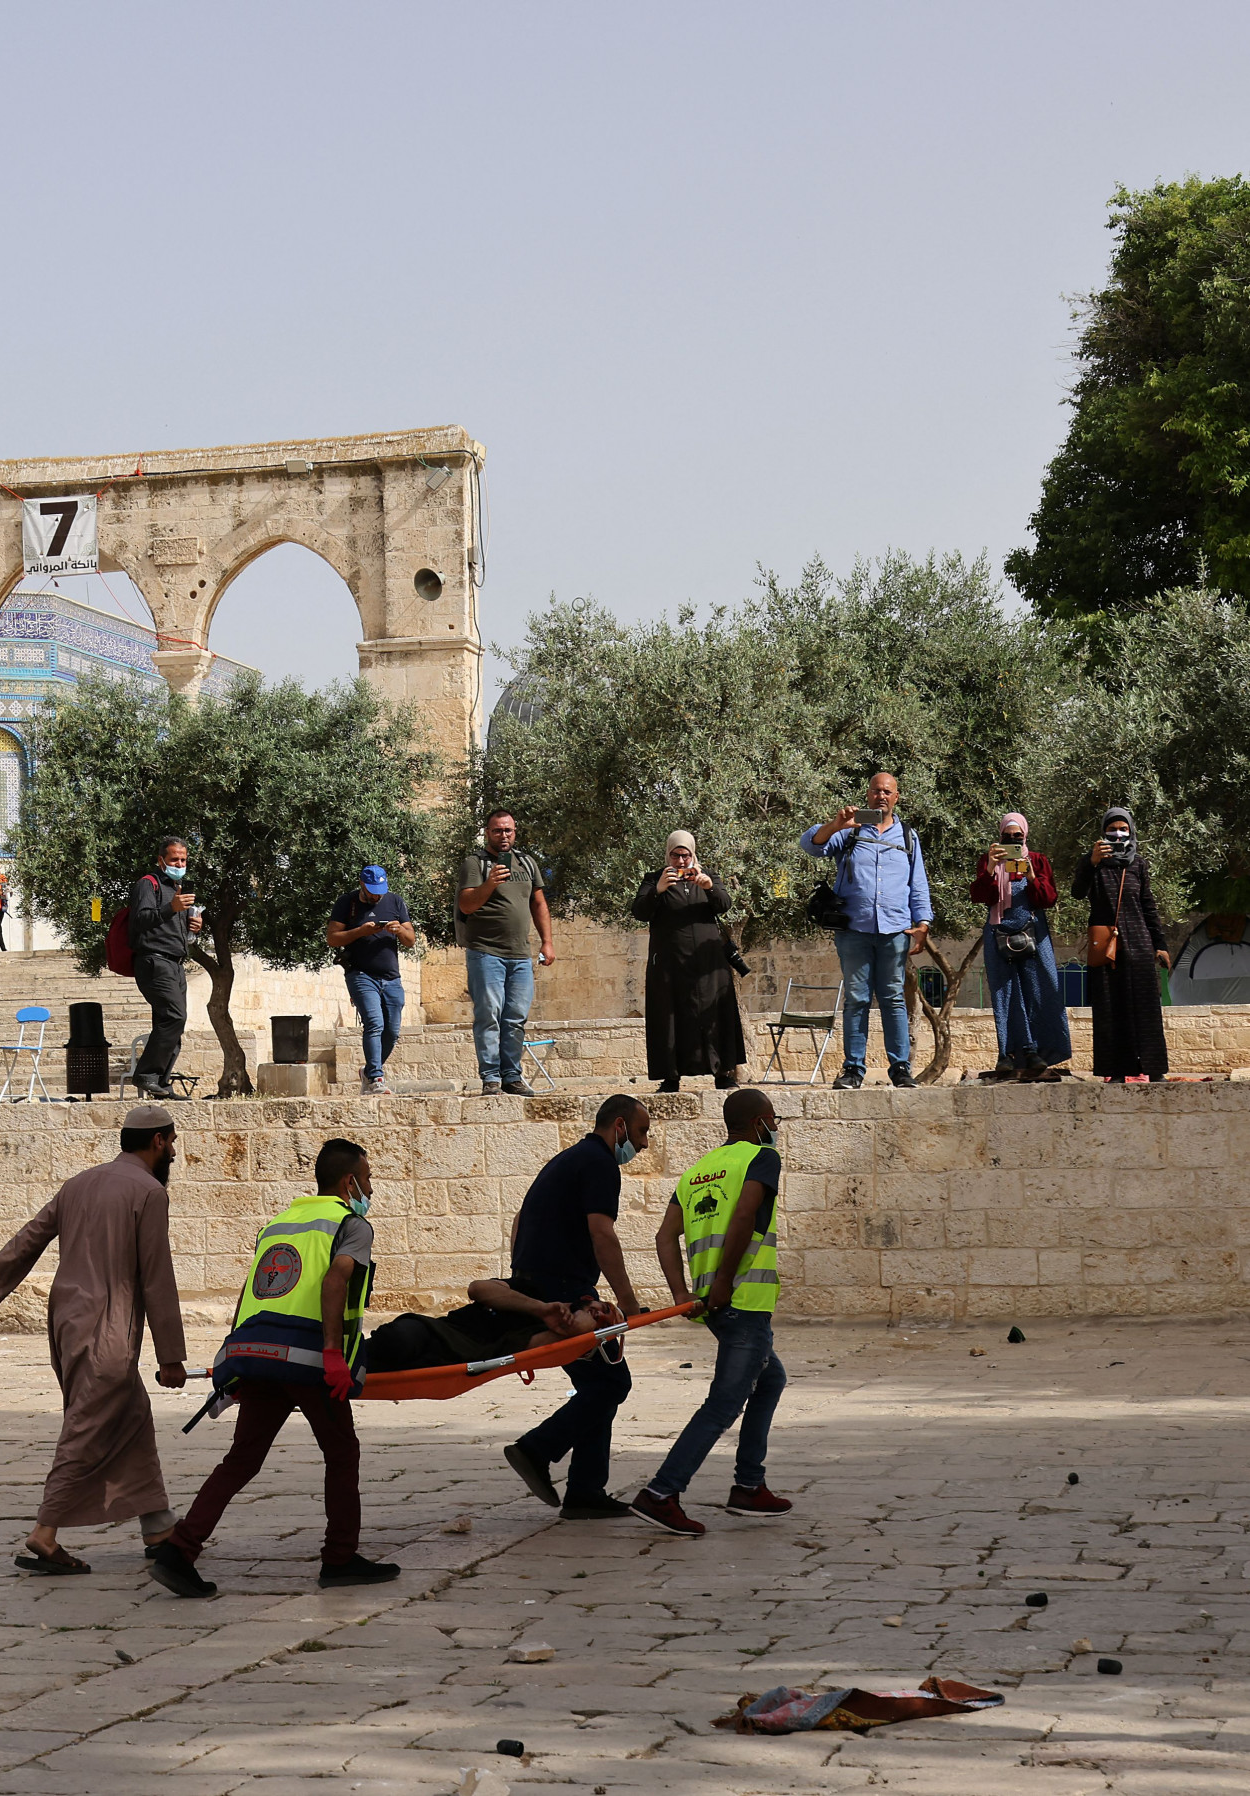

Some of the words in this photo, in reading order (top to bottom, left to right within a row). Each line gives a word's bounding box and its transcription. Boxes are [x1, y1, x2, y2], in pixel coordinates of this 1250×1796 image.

[40, 501, 78, 556] 7
[26, 561, 67, 575] المرواني
[689, 1169, 727, 1186] مسعف
[230, 1344, 279, 1357] مسعف
